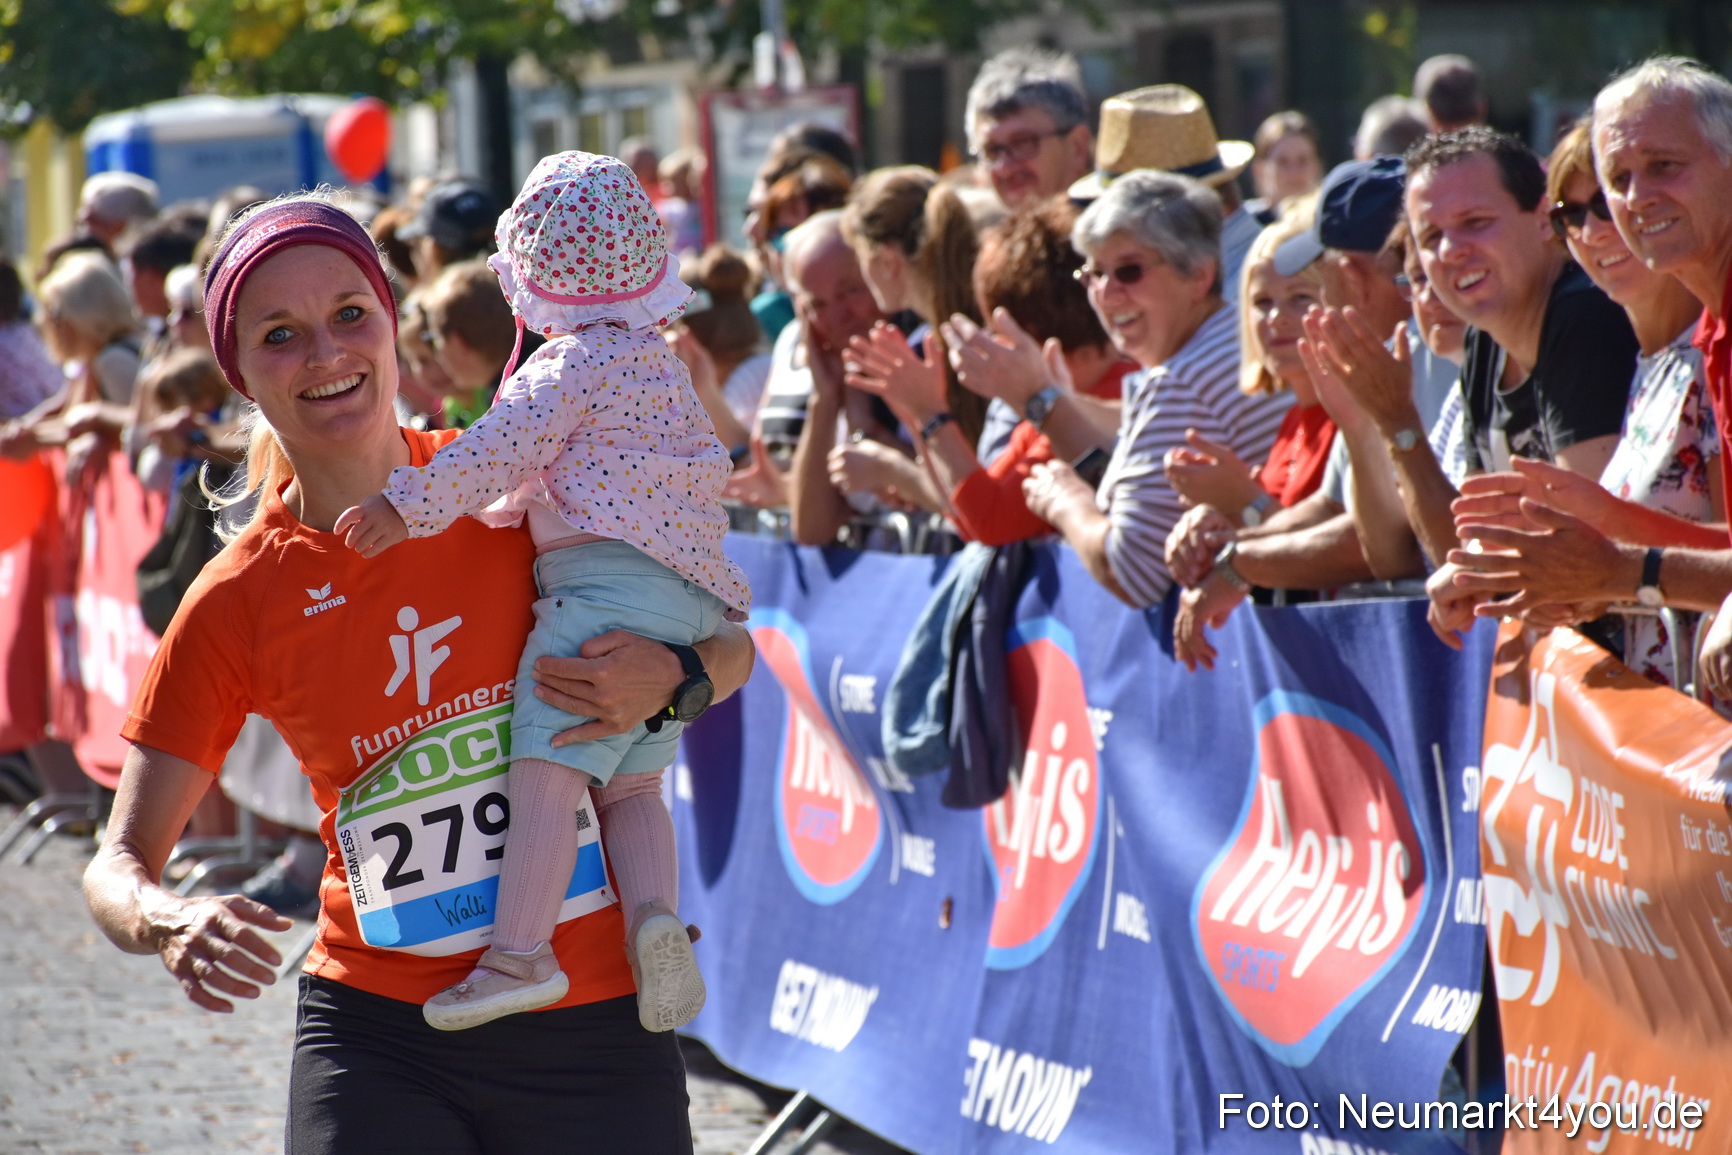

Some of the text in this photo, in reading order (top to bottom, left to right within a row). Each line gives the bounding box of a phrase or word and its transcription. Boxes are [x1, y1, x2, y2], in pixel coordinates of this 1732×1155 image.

[303, 594, 347, 617] erima
[350, 679, 516, 768] funrunners
[371, 792, 510, 891] 279
[1572, 777, 1628, 870] CODE
[1680, 813, 1730, 856] für die
[434, 893, 488, 928] Walli
[1209, 771, 1411, 980] Hervis
[1565, 866, 1678, 959] CLINIC
[1222, 941, 1287, 993] SPORTS
[1562, 1051, 1710, 1154] Agentur
